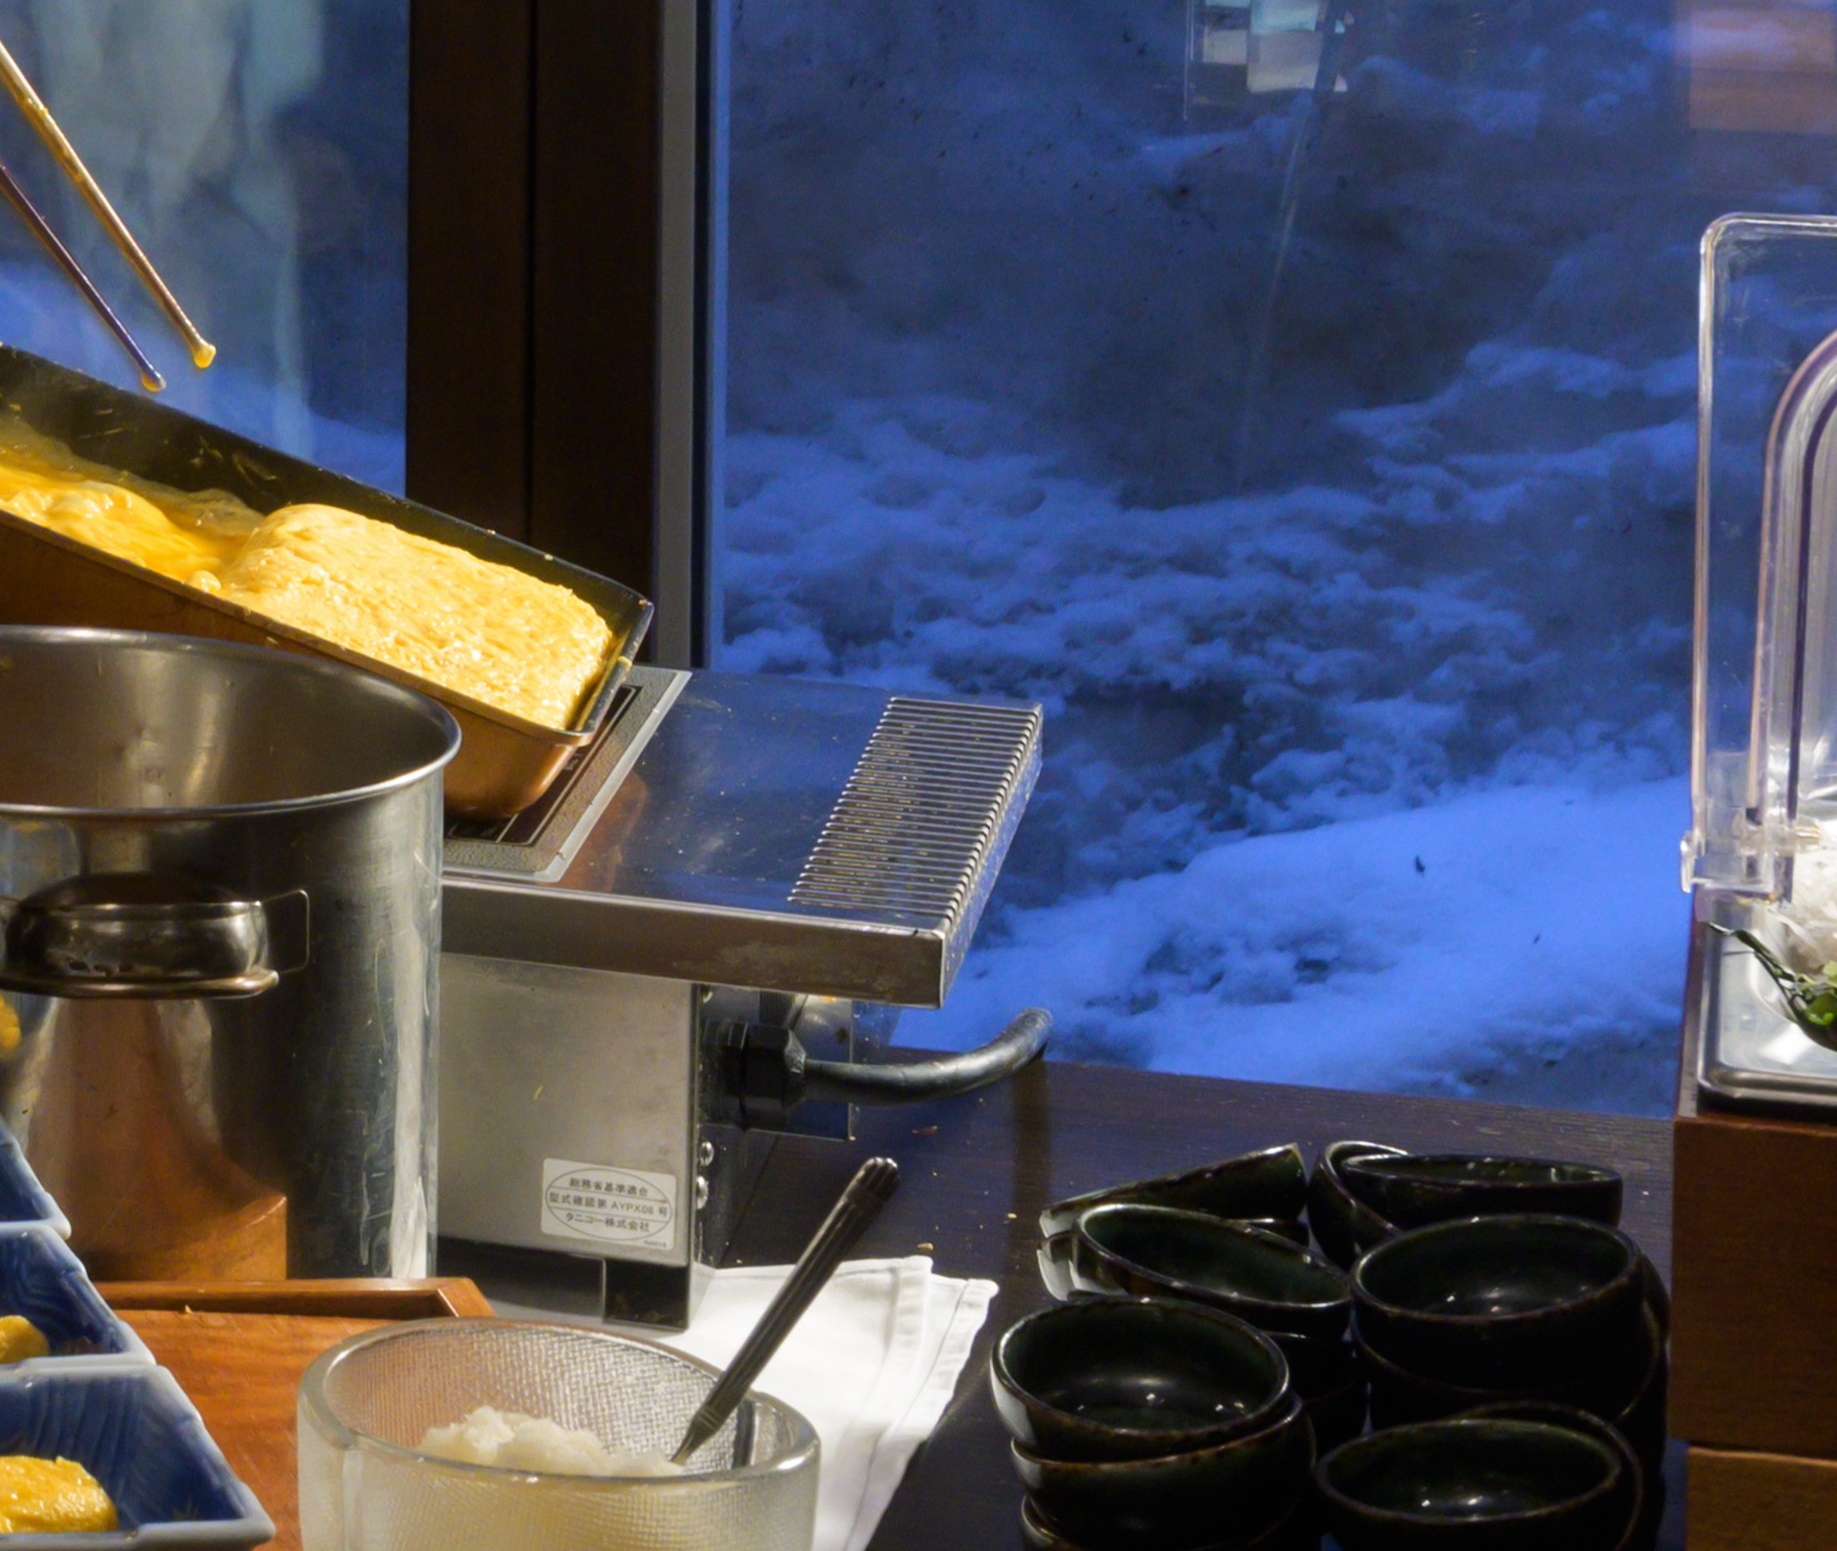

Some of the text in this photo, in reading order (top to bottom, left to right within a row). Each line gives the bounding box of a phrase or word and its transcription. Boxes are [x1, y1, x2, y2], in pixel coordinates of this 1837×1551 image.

[565, 1212, 650, 1232] タニコー株式会社
